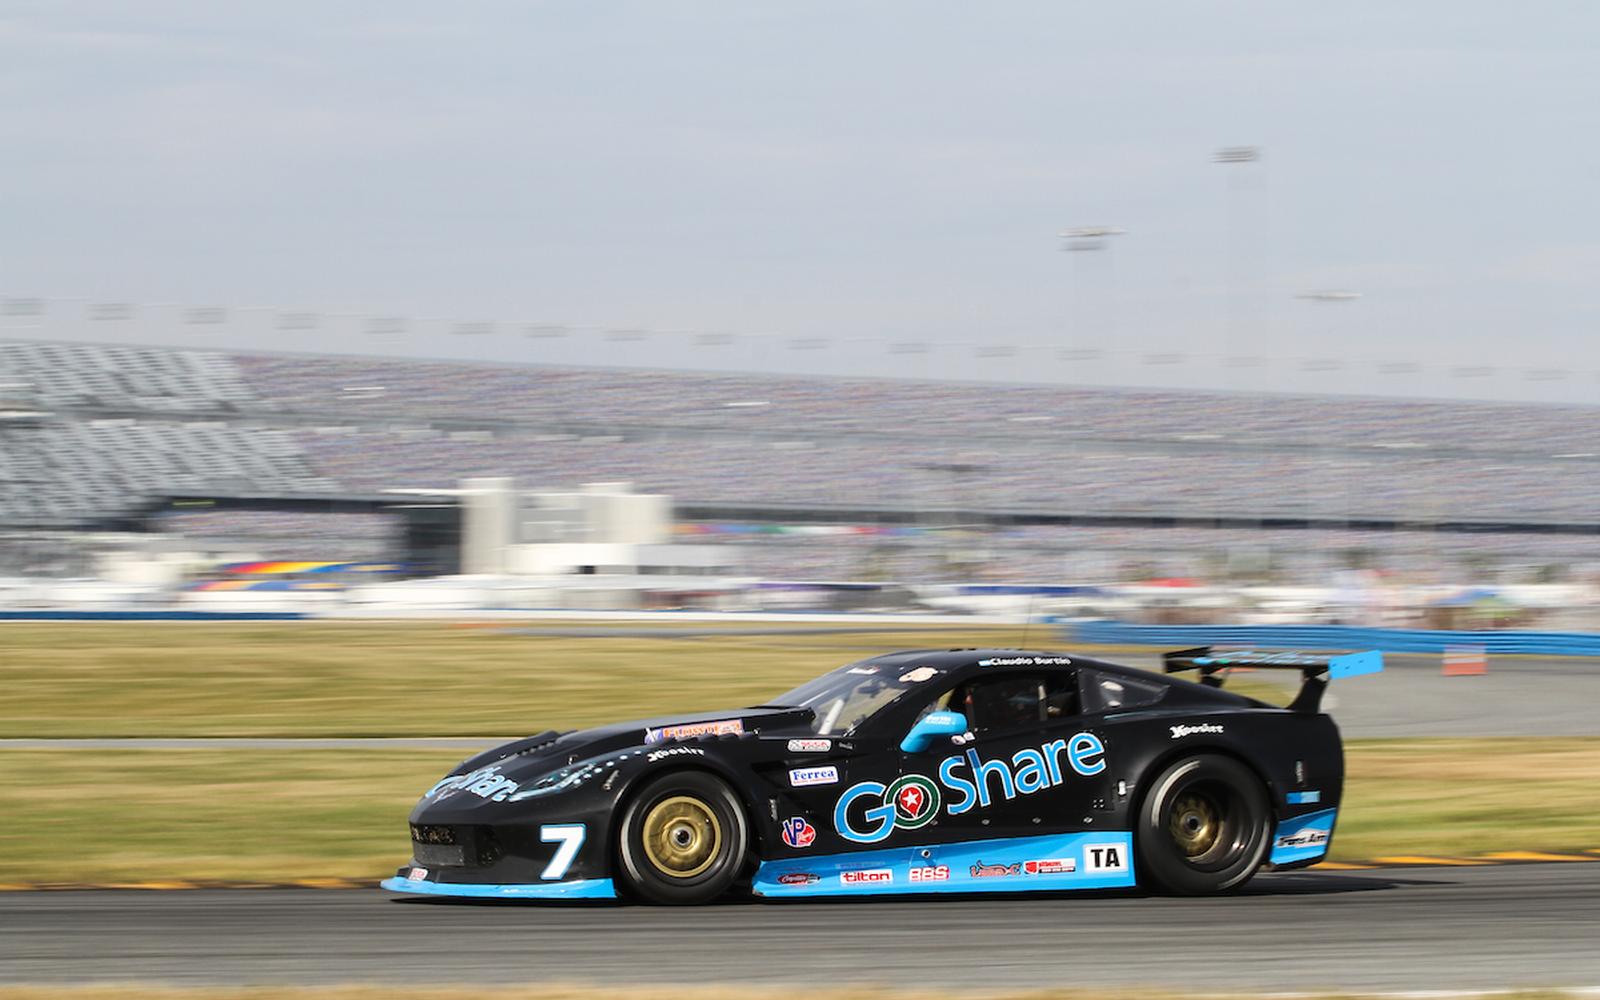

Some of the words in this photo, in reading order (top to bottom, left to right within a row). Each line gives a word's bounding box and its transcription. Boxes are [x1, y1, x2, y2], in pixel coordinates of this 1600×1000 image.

[793, 770, 835, 781] Ferrea
[539, 824, 587, 880] 7
[1090, 848, 1121, 868] TA
[842, 871, 890, 883] tilton
[909, 866, 950, 882] BBS
